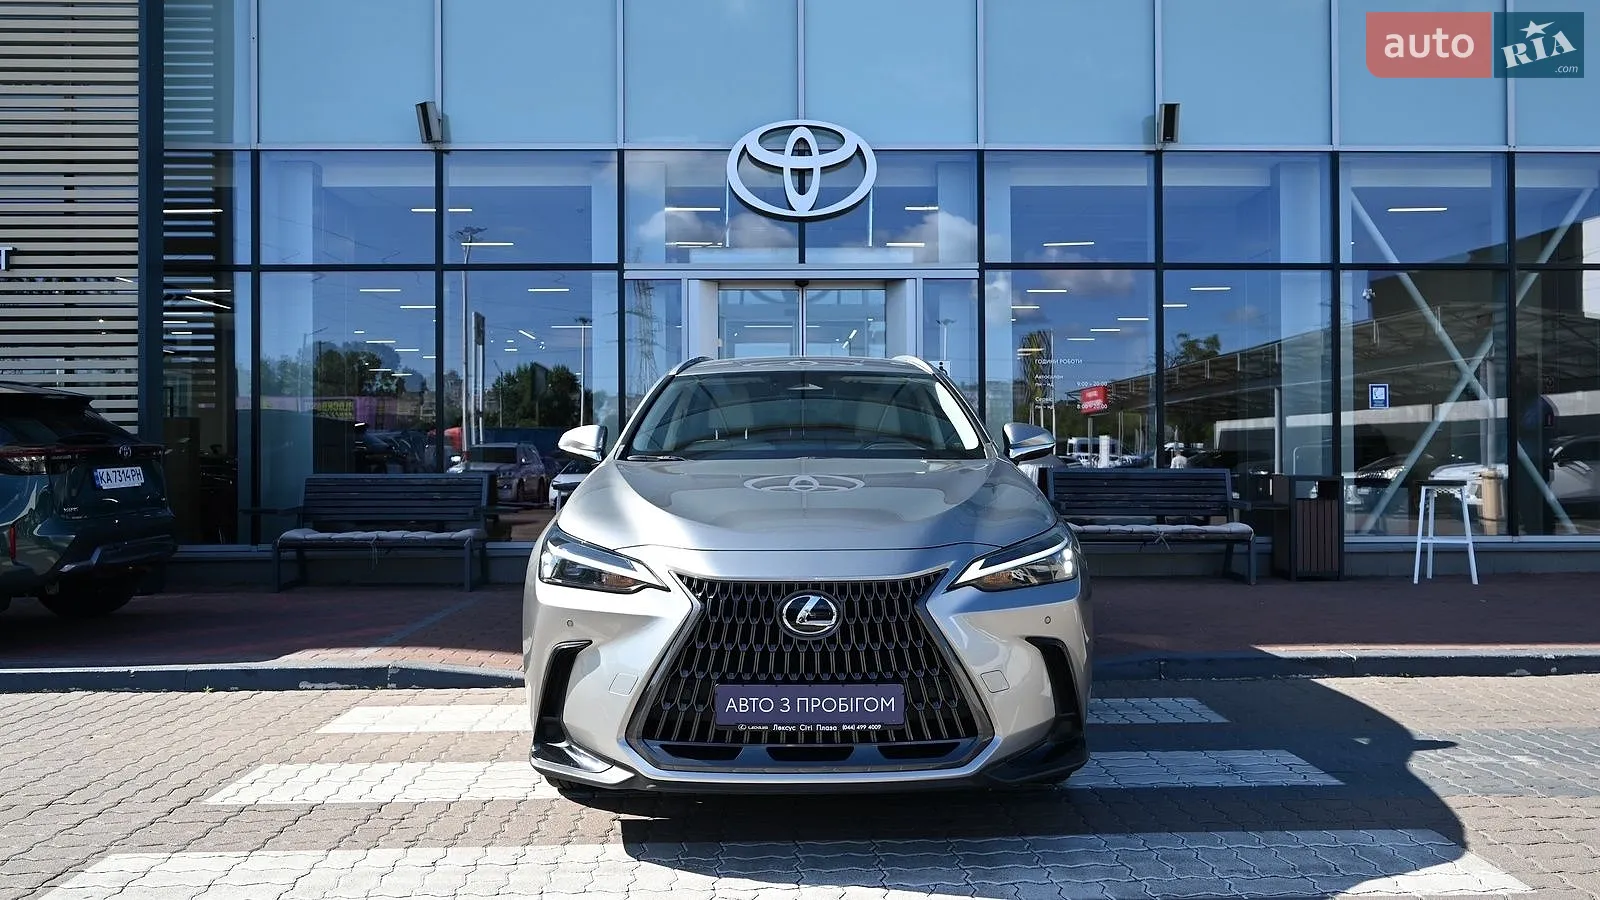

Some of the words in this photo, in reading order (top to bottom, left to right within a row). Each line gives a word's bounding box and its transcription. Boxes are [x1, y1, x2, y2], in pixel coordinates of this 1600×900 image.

[111, 469, 131, 483] 7314
[725, 696, 775, 713] АВТО
[796, 696, 896, 713] ПРОБІГОМ
[772, 723, 797, 732] Лексус
[815, 723, 838, 731] Плаза
[842, 723, 856, 731] (044)
